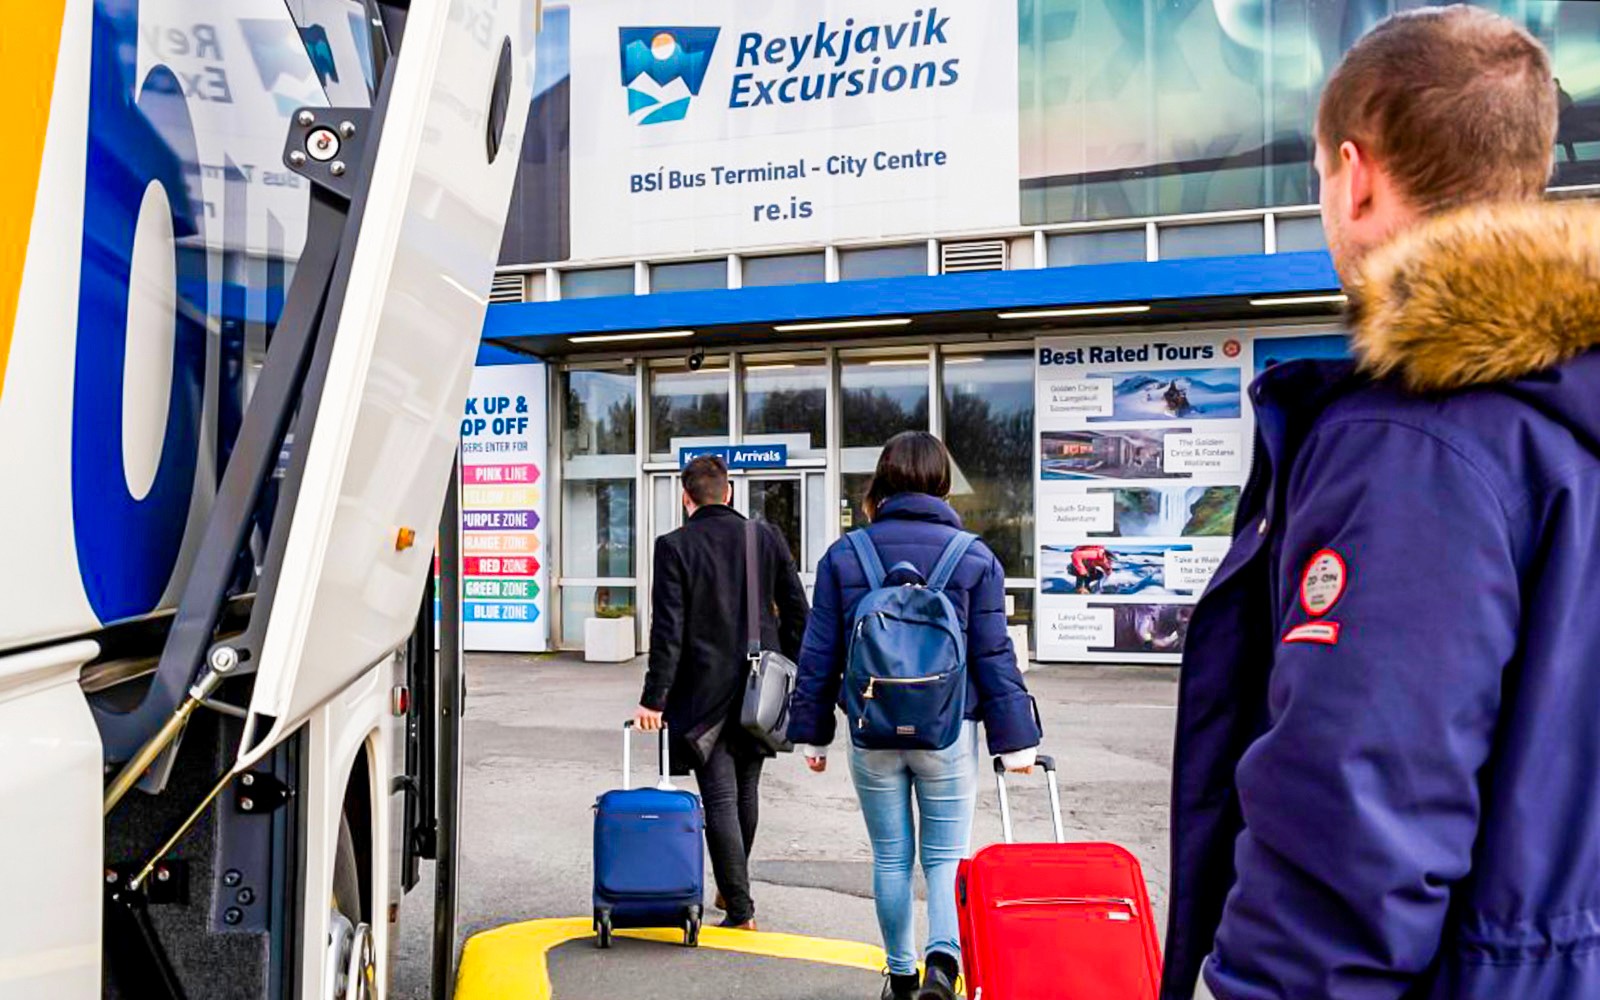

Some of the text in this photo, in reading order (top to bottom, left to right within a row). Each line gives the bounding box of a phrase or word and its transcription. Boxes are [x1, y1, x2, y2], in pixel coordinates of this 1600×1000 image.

[735, 7, 951, 73] Reykjavik
[728, 56, 960, 109] Excursions
[630, 166, 663, 193] BSÍ
[668, 170, 706, 190] Bus
[711, 159, 806, 186] Terminal
[826, 155, 867, 178] City
[873, 149, 947, 171] Centre
[752, 196, 813, 222] re.is
[1039, 347, 1085, 366] Best
[1089, 344, 1149, 364] Rated
[1153, 343, 1214, 361] Tours
[483, 396, 510, 415] UP
[515, 395, 528, 414] &
[492, 417, 529, 436] OFF
[485, 441, 510, 453] ENTER
[513, 441, 528, 452] FOR
[733, 450, 781, 463] Arrivals
[475, 466, 528, 481] PINK LINE
[502, 512, 528, 527] ZONE
[502, 536, 528, 550] ZONE
[479, 558, 528, 573] RED ZONE
[465, 581, 528, 597] GREEN ZONE
[474, 604, 528, 620] BLUE ZONE
